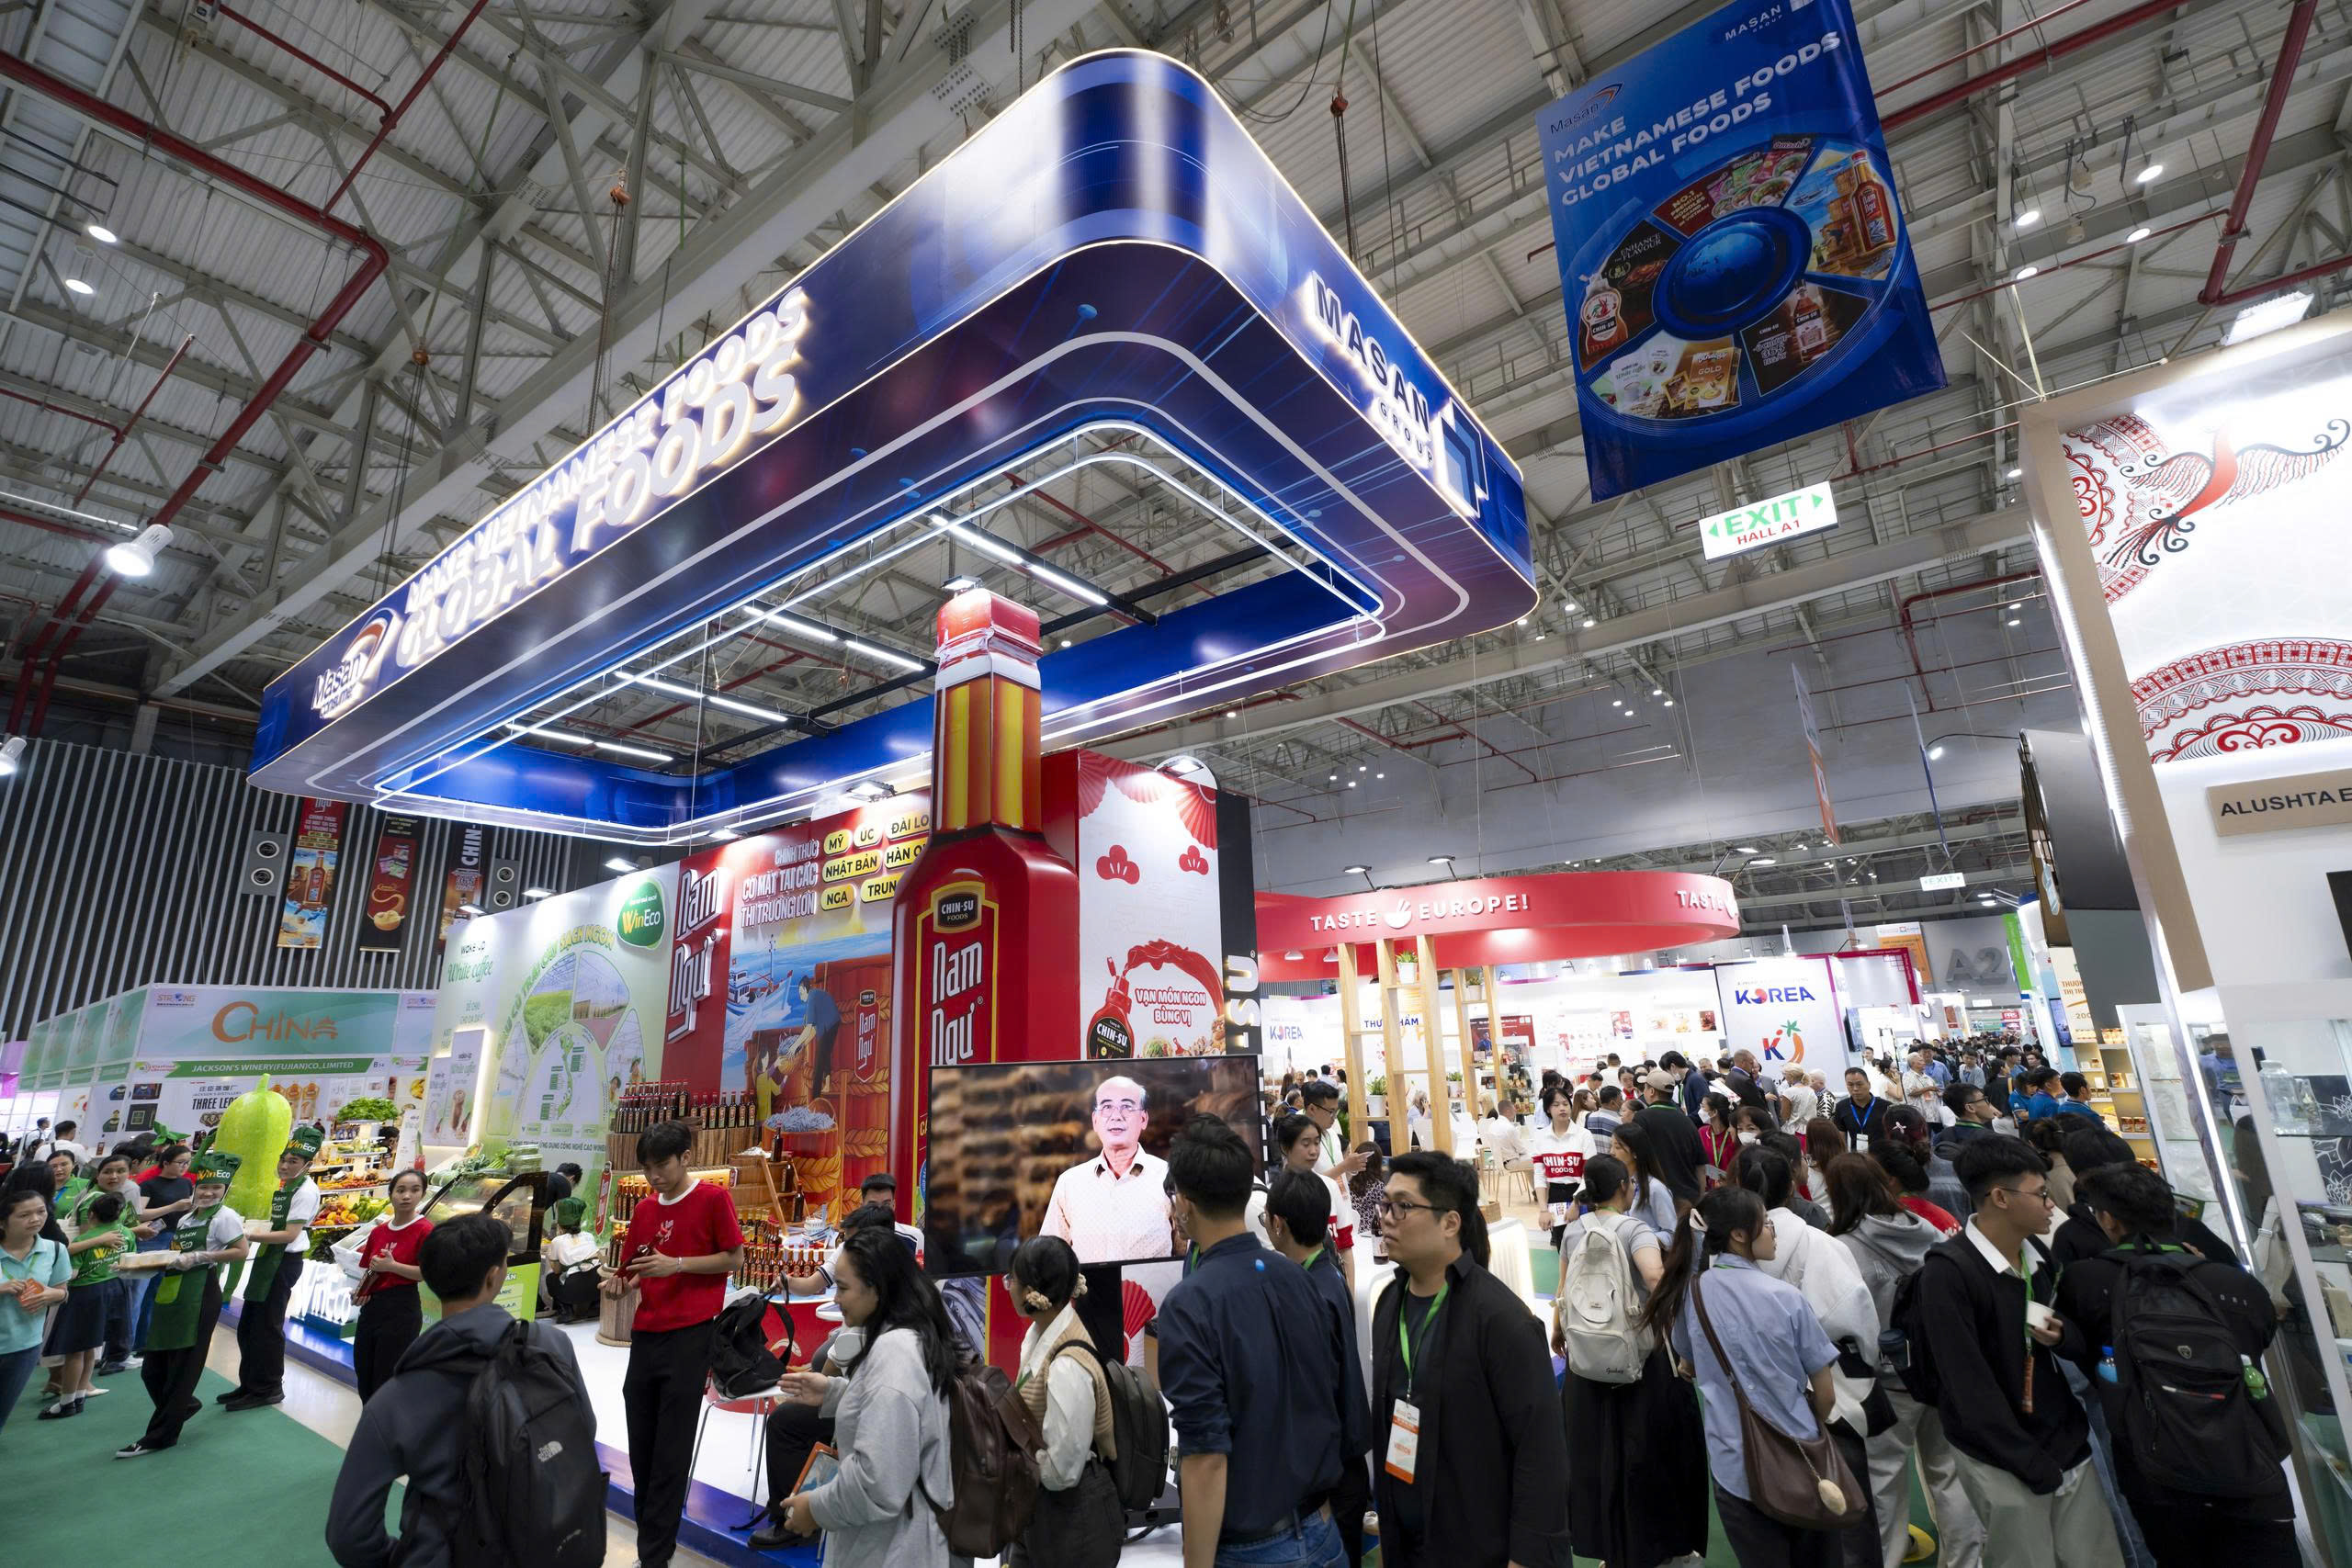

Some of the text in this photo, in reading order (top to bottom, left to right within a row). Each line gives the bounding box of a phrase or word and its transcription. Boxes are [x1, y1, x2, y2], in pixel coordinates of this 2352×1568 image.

[1725, 5, 1781, 40] MASAN
[1550, 102, 1600, 135] Masan
[1559, 30, 1841, 184] VIETNAMESE FOODS
[1554, 116, 1626, 164] MAKE
[1562, 92, 1772, 207] GLOBAL FOODS
[1672, 190, 1695, 209] NO.1
[1312, 270, 1431, 439] MASAN
[1698, 366, 1722, 376] GOLD
[1380, 401, 1434, 464] GROUP
[405, 540, 475, 614] MAKE
[662, 286, 804, 427] FOODS
[396, 340, 797, 669] GLOBAL FOODS
[1724, 495, 1802, 536] EXIT
[1737, 528, 1777, 545] HALL
[311, 651, 368, 711] Masan
[2221, 787, 2352, 817] ALUSHTA E
[891, 814, 930, 834] ĐÀI LO
[460, 824, 482, 866] CHIN-
[829, 833, 844, 850] MỸ
[887, 846, 910, 864] HÀN
[825, 856, 877, 879] NHẬT BẢN
[867, 879, 898, 897] TRUN
[1927, 875, 1955, 886] EXIT
[676, 868, 719, 942] Nam
[826, 891, 848, 906] NGA
[941, 899, 974, 915] CHIN-SU
[622, 908, 661, 934] WinEco
[946, 913, 969, 921] FOODS
[1310, 893, 1529, 931] TASTE EUROPE!
[932, 941, 982, 1005] Nam
[1946, 946, 2008, 986] A2
[1135, 986, 1207, 1008] VẠN MÓN NGON
[1736, 986, 1816, 1005] KOREA
[211, 1000, 339, 1043] CHINA
[858, 1012, 876, 1037] Nam
[1153, 1005, 1193, 1027] BÙNG VỊ
[1363, 1019, 1383, 1030] THỰ
[1096, 1022, 1128, 1047] CHIN-SU
[1270, 1025, 1304, 1041] KOREA
[191, 1063, 241, 1073] JACKSON'S
[192, 1098, 217, 1111] THREE
[288, 1138, 317, 1153] WinEco
[198, 1169, 231, 1180] WinEco
[1550, 1167, 1575, 1175] FOODS
